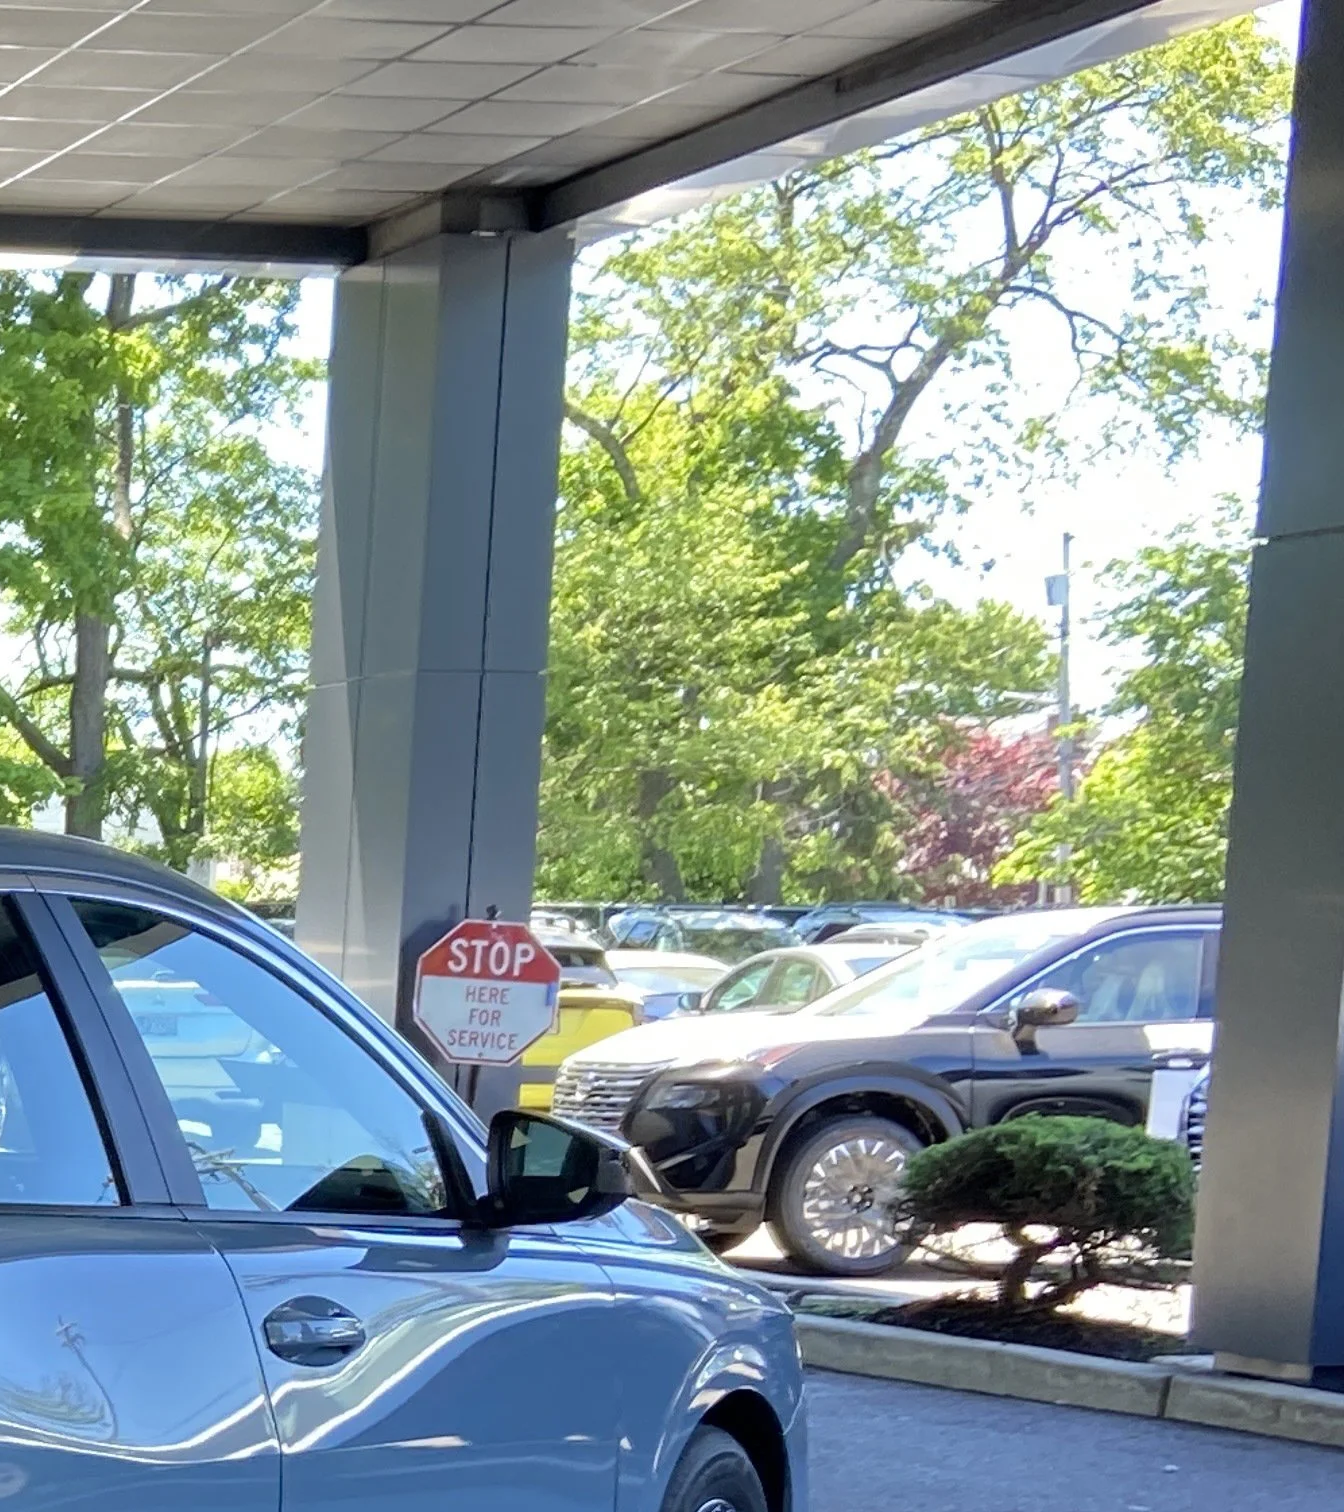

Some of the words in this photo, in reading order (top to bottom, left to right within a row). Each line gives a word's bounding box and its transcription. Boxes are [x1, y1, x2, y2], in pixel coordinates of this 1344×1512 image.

[447, 938, 535, 977] STOP
[465, 985, 510, 1005] HERE
[468, 1008, 502, 1027] FOR
[447, 1028, 518, 1050] SERVICE
